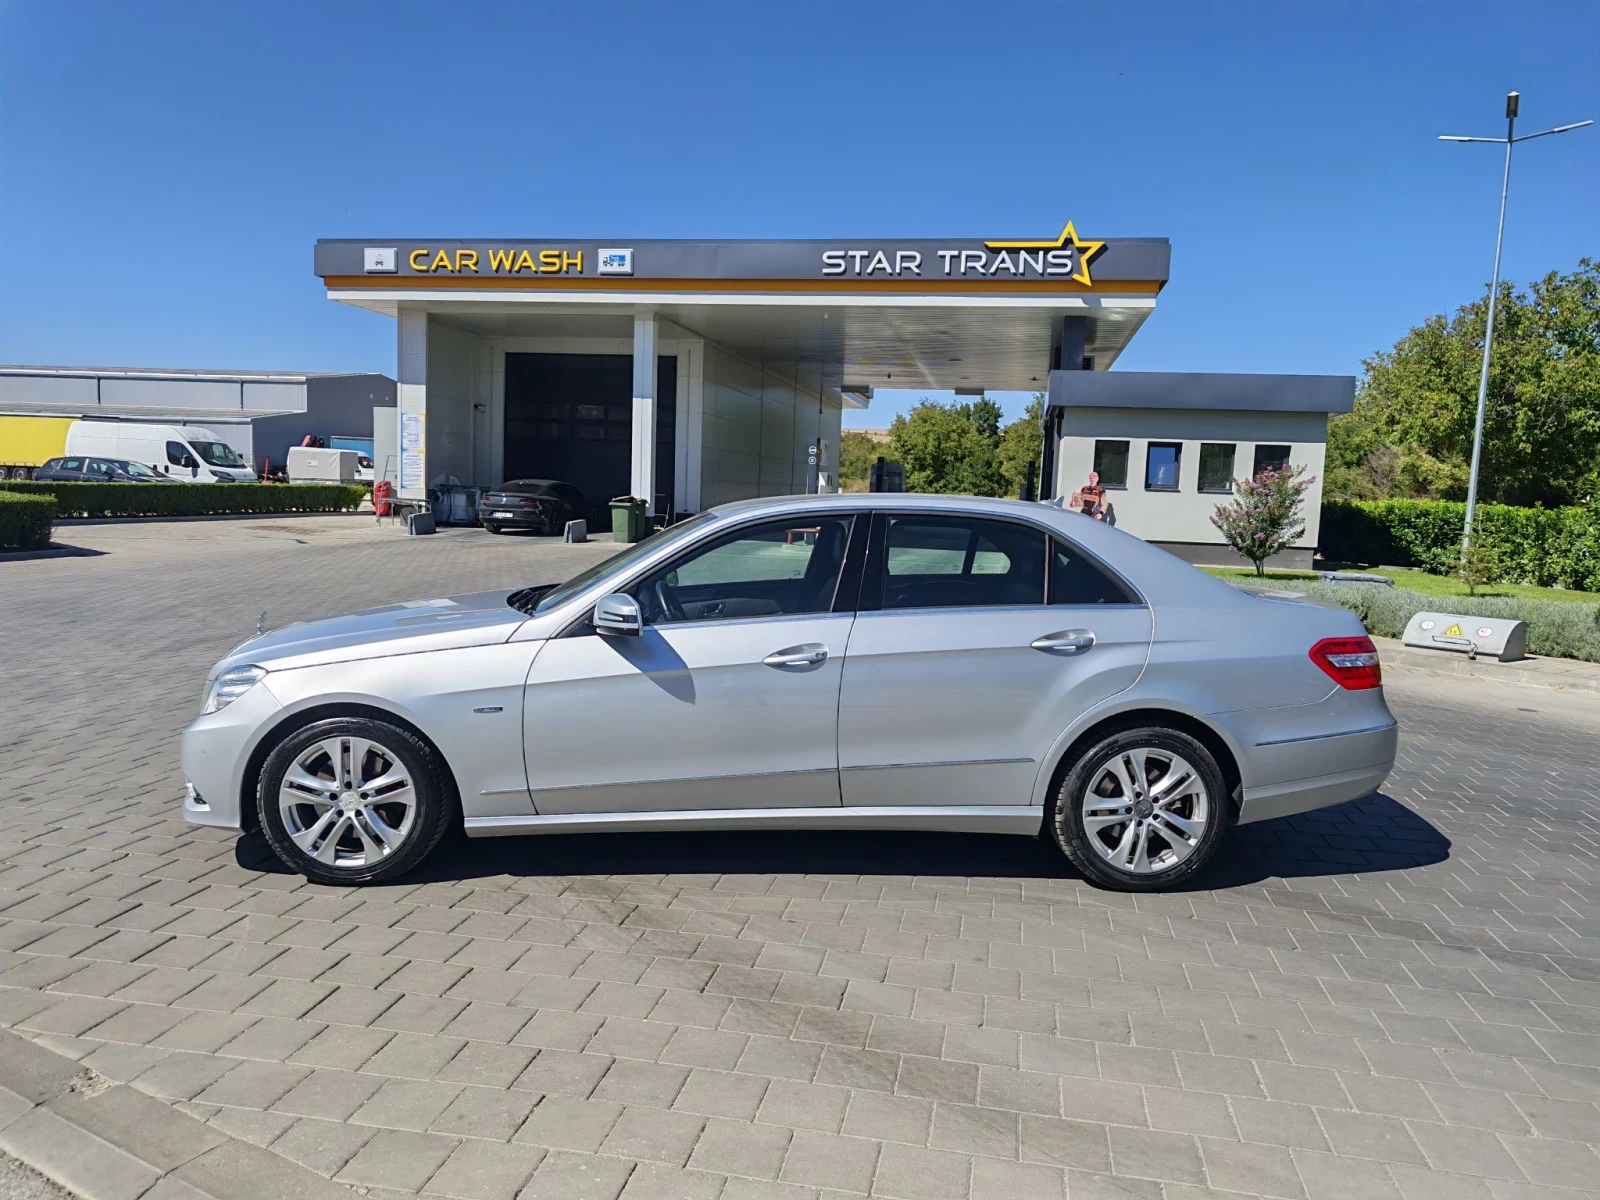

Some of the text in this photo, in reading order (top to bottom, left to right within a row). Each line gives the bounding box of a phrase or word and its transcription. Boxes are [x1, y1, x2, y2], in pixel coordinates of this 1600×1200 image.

[409, 249, 583, 273] CAR WASH
[822, 250, 1073, 274] STAR TRANS
